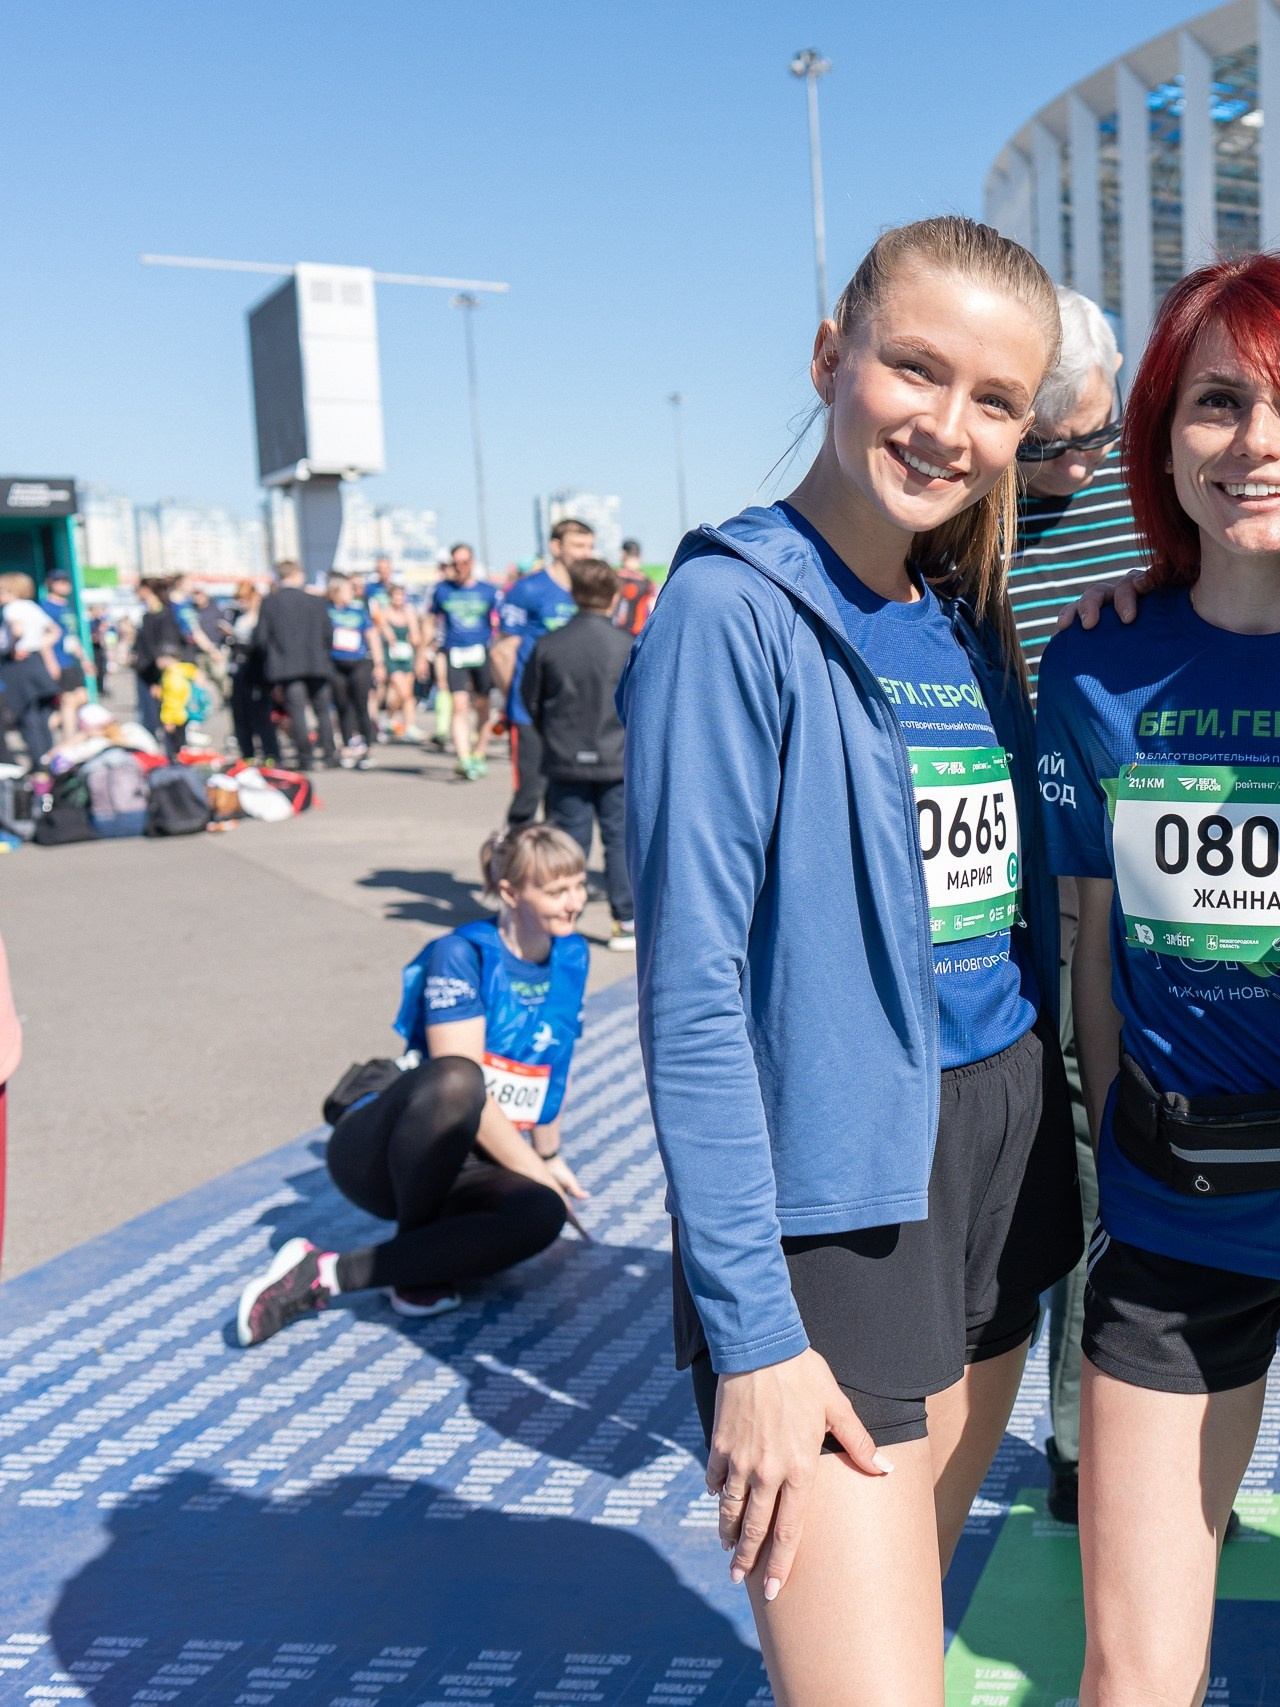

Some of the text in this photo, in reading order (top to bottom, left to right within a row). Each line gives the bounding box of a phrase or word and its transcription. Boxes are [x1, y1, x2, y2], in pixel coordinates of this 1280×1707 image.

[877, 677, 928, 708] ЕГИ,
[1138, 709, 1226, 739] БЕГИ,
[1135, 752, 1146, 760] 10
[1147, 752, 1270, 763] БЛАГОТВОРИТЕЛЬНЫЙ
[1128, 777, 1146, 789] 21,1
[947, 865, 993, 890] МАРИЯ
[954, 951, 1010, 973] НОВГОРО
